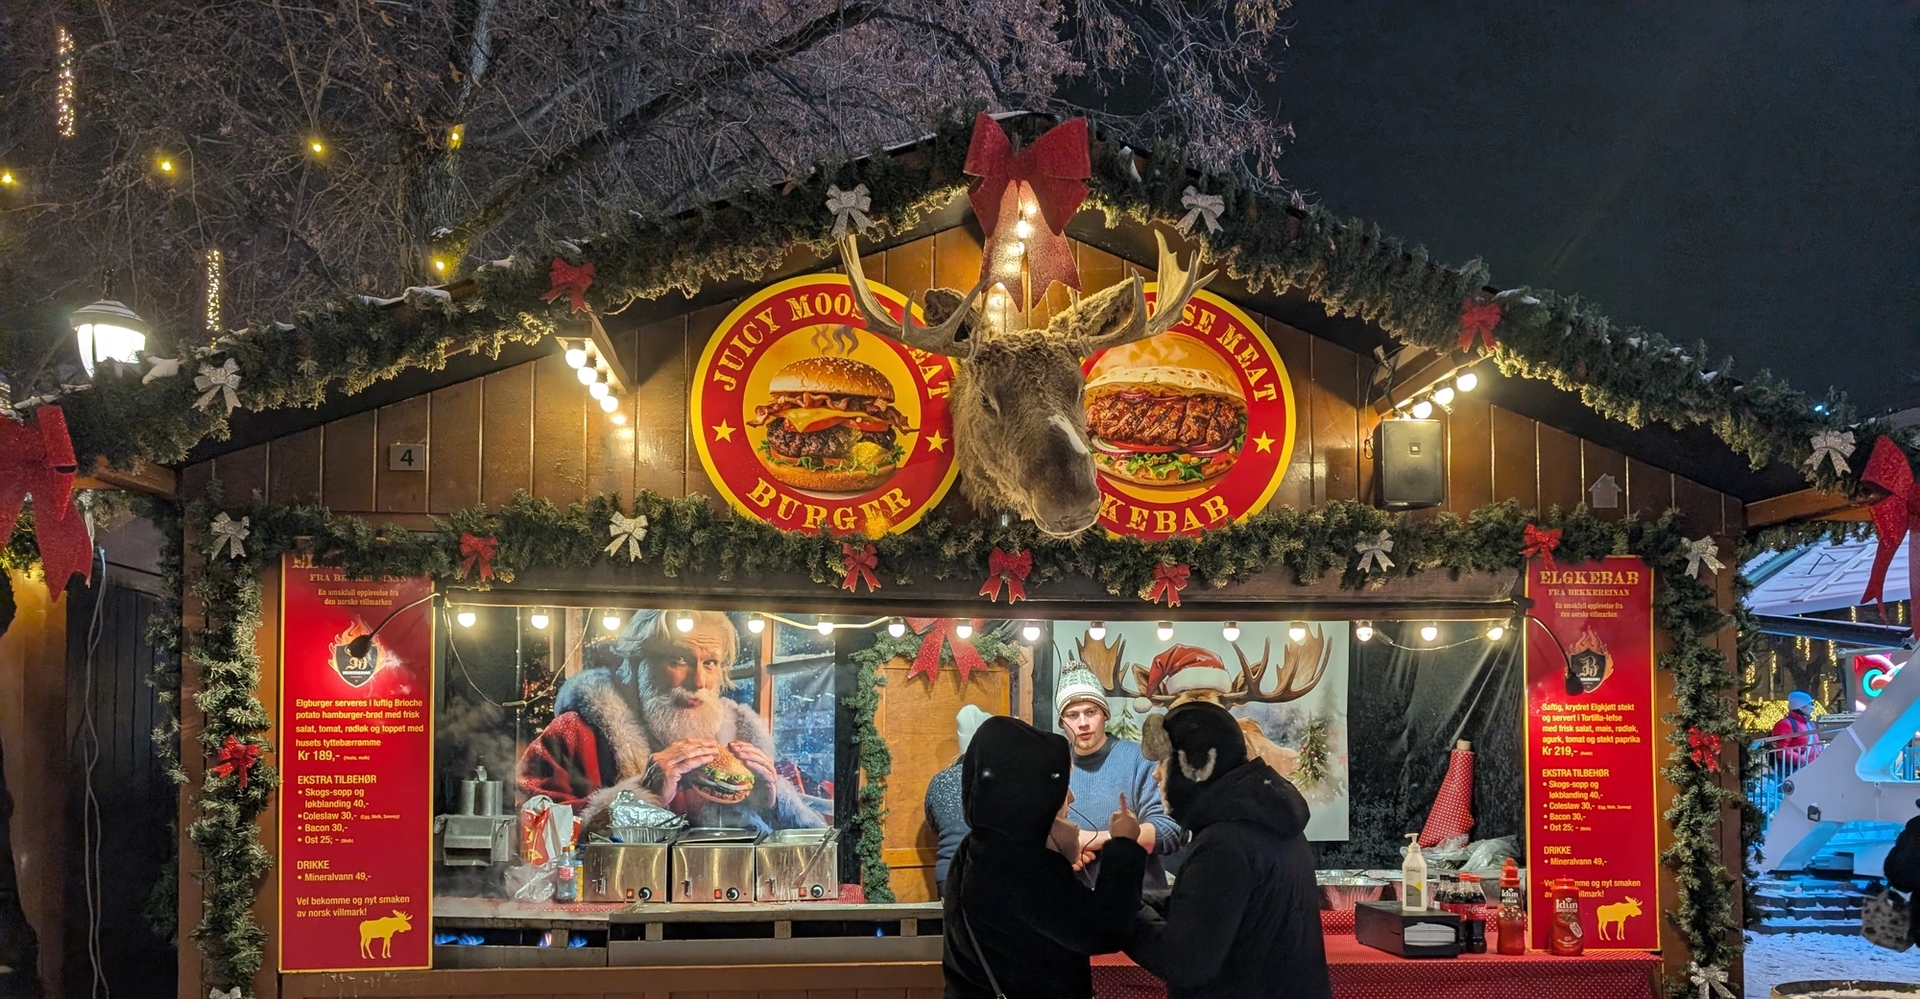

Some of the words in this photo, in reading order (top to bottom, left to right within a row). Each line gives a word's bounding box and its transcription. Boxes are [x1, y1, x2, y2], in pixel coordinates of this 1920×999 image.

[712, 306, 781, 392] JUICY
[904, 344, 950, 399] EAT
[1215, 323, 1278, 402] MEAT
[400, 449, 414, 466] 4
[746, 477, 912, 534] BURGER
[1101, 494, 1230, 533] KEBAB
[310, 574, 330, 582] FRA
[1540, 571, 1639, 584] ELGKEBAB
[318, 588, 326, 596] En
[328, 588, 355, 596] smakfull
[357, 588, 388, 597] opplevelse
[390, 588, 398, 596] fra
[296, 699, 333, 708] Elgburger
[369, 699, 372, 707] i
[374, 699, 393, 708] luftig
[395, 699, 423, 707] Brioche
[1542, 703, 1563, 712] Saftig,
[1565, 704, 1589, 712] krydret
[1591, 703, 1616, 712] Elgkjøtt
[296, 712, 320, 720] potato
[322, 711, 383, 720] hamburger-brød
[1542, 715, 1551, 723] og
[296, 725, 317, 733] salat,
[319, 725, 343, 733] tomat,
[382, 725, 405, 733] toppet
[1575, 725, 1594, 733] salat,
[1615, 725, 1638, 733] rødløk,
[296, 739, 321, 747] husets
[323, 739, 381, 748] tyttebærrømme
[1542, 736, 1564, 744] agurk,
[1586, 736, 1595, 744] og
[1615, 736, 1640, 744] paprika
[298, 751, 310, 760] Kr
[313, 750, 340, 762] 189,-
[1542, 746, 1552, 755] Kr
[1554, 746, 1577, 757] 219,-
[1542, 769, 1571, 777] EKSTRA
[1572, 769, 1609, 777] TILBEHØR
[298, 775, 332, 784] EKSTRA
[334, 775, 376, 784] TILBEHØR
[1549, 780, 1589, 789] Skogs-sopp
[305, 788, 352, 797] Skogs-sopp
[354, 789, 364, 797] og
[1549, 791, 1588, 800] løkblanding
[1590, 791, 1603, 799] 40,-
[305, 800, 351, 809] løkblanding
[353, 800, 369, 808] 40,-
[1581, 802, 1595, 810] 30,-
[303, 812, 339, 820] Coleslaw
[341, 812, 357, 820] 30,-
[1572, 813, 1586, 821] 30,-
[332, 823, 348, 832] 30,-
[1544, 846, 1571, 854] DRIKKE
[297, 860, 329, 869] DRIKKE
[1593, 858, 1607, 866] 49,-
[305, 873, 353, 881] Mineralvann
[355, 872, 371, 881] 49,-
[1602, 880, 1612, 888] nyt
[1502, 889, 1518, 897] Idun
[297, 897, 309, 905] Vel
[379, 895, 409, 903] smaken
[1556, 899, 1578, 909] Idun
[308, 909, 331, 917] norsk
[333, 908, 367, 916] villmark!
